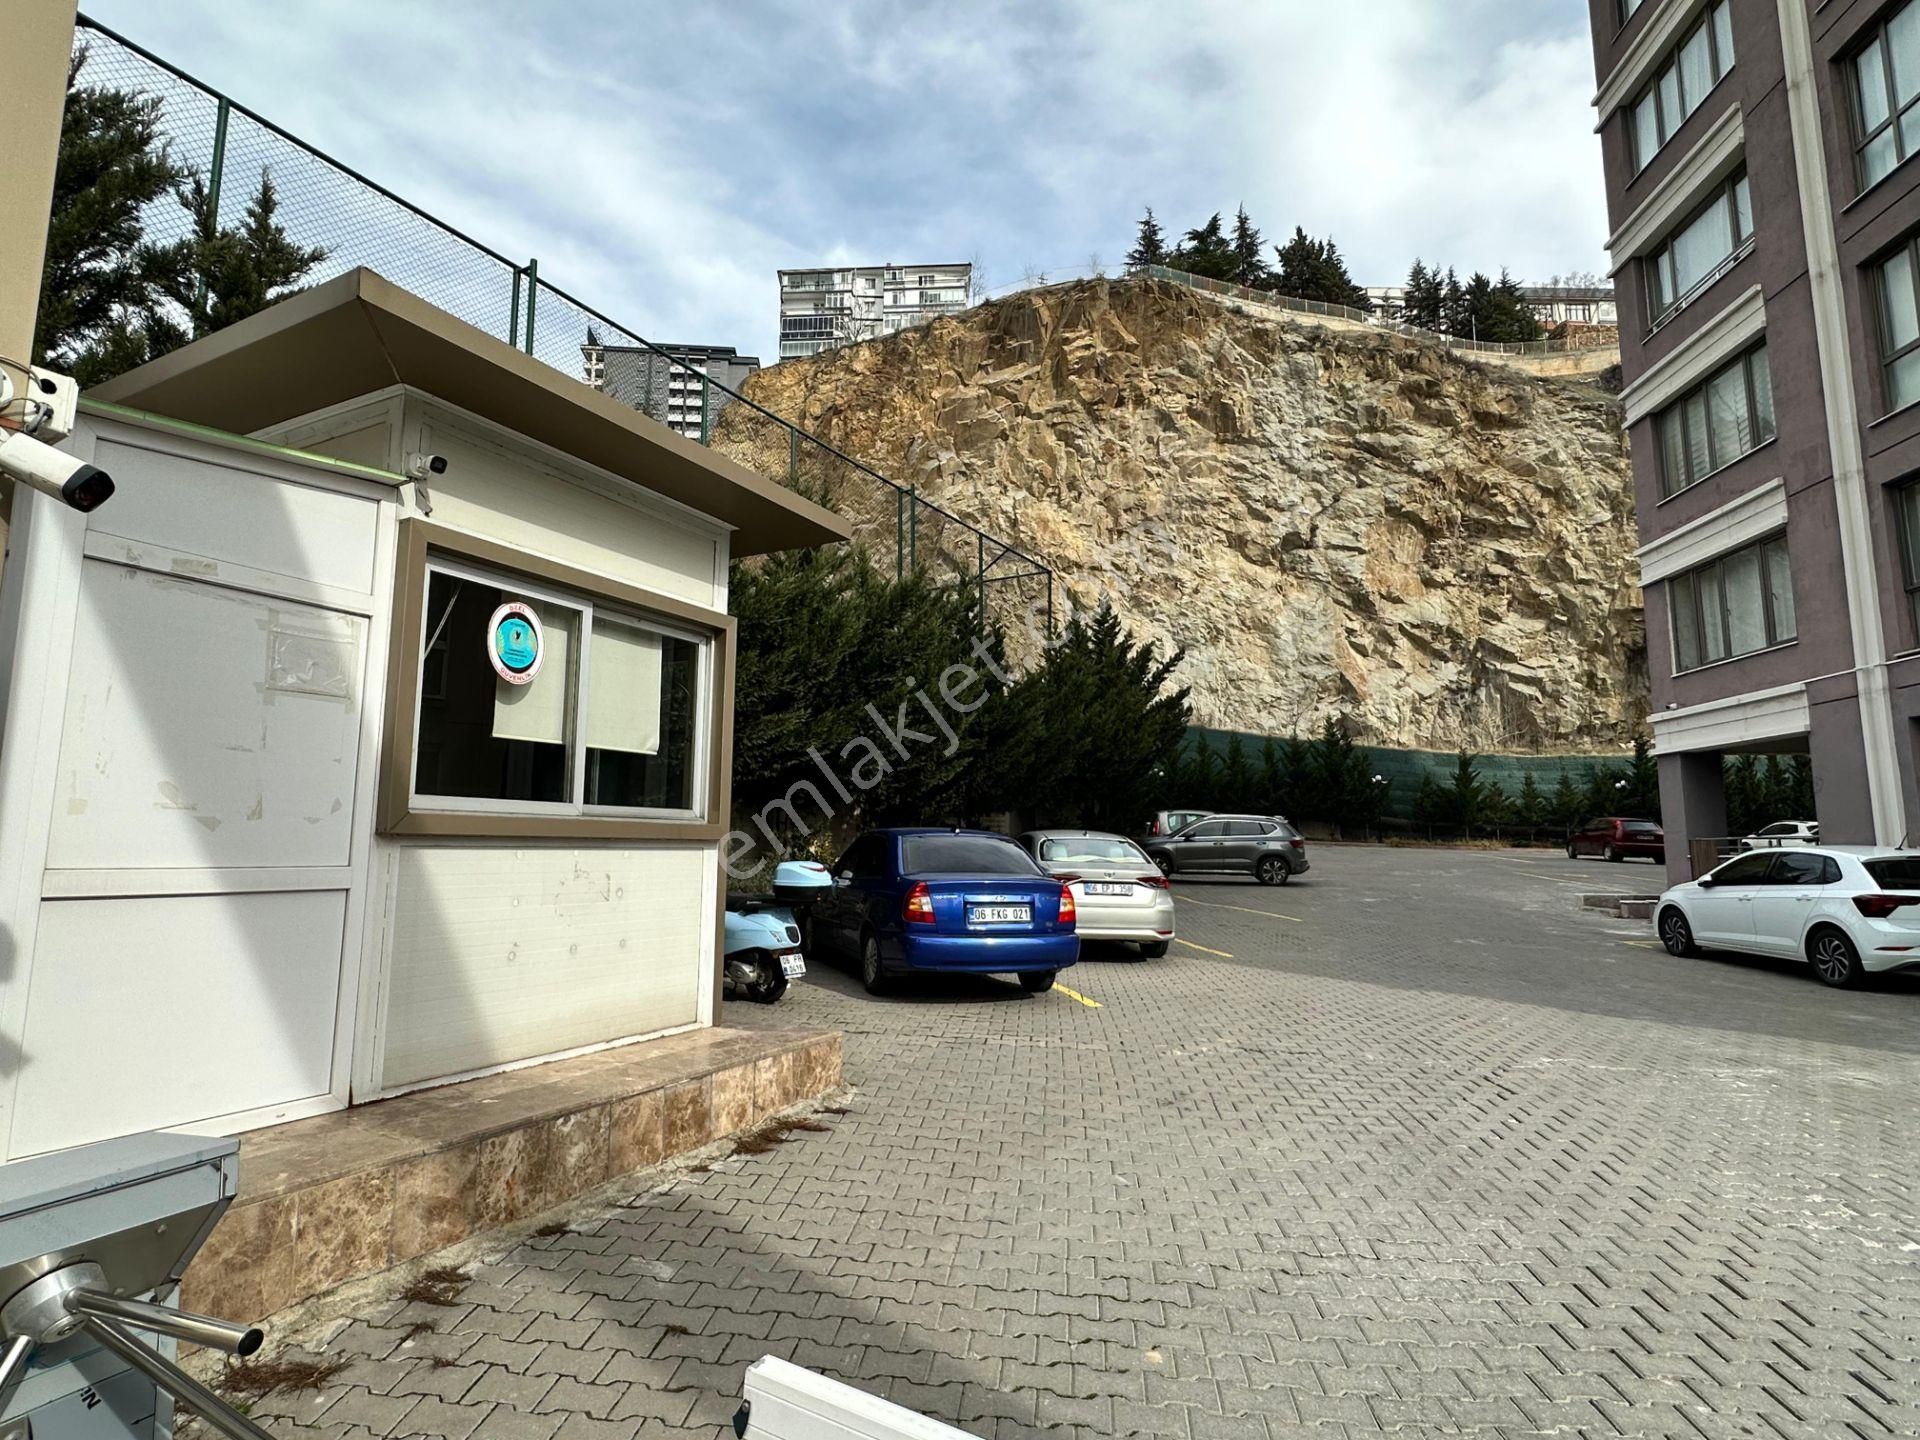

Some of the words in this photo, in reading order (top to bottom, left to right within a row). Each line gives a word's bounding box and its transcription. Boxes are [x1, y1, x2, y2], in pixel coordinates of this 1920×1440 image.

[974, 909, 987, 920] 06
[991, 909, 1008, 920] FKG
[1013, 909, 1029, 920] 021
